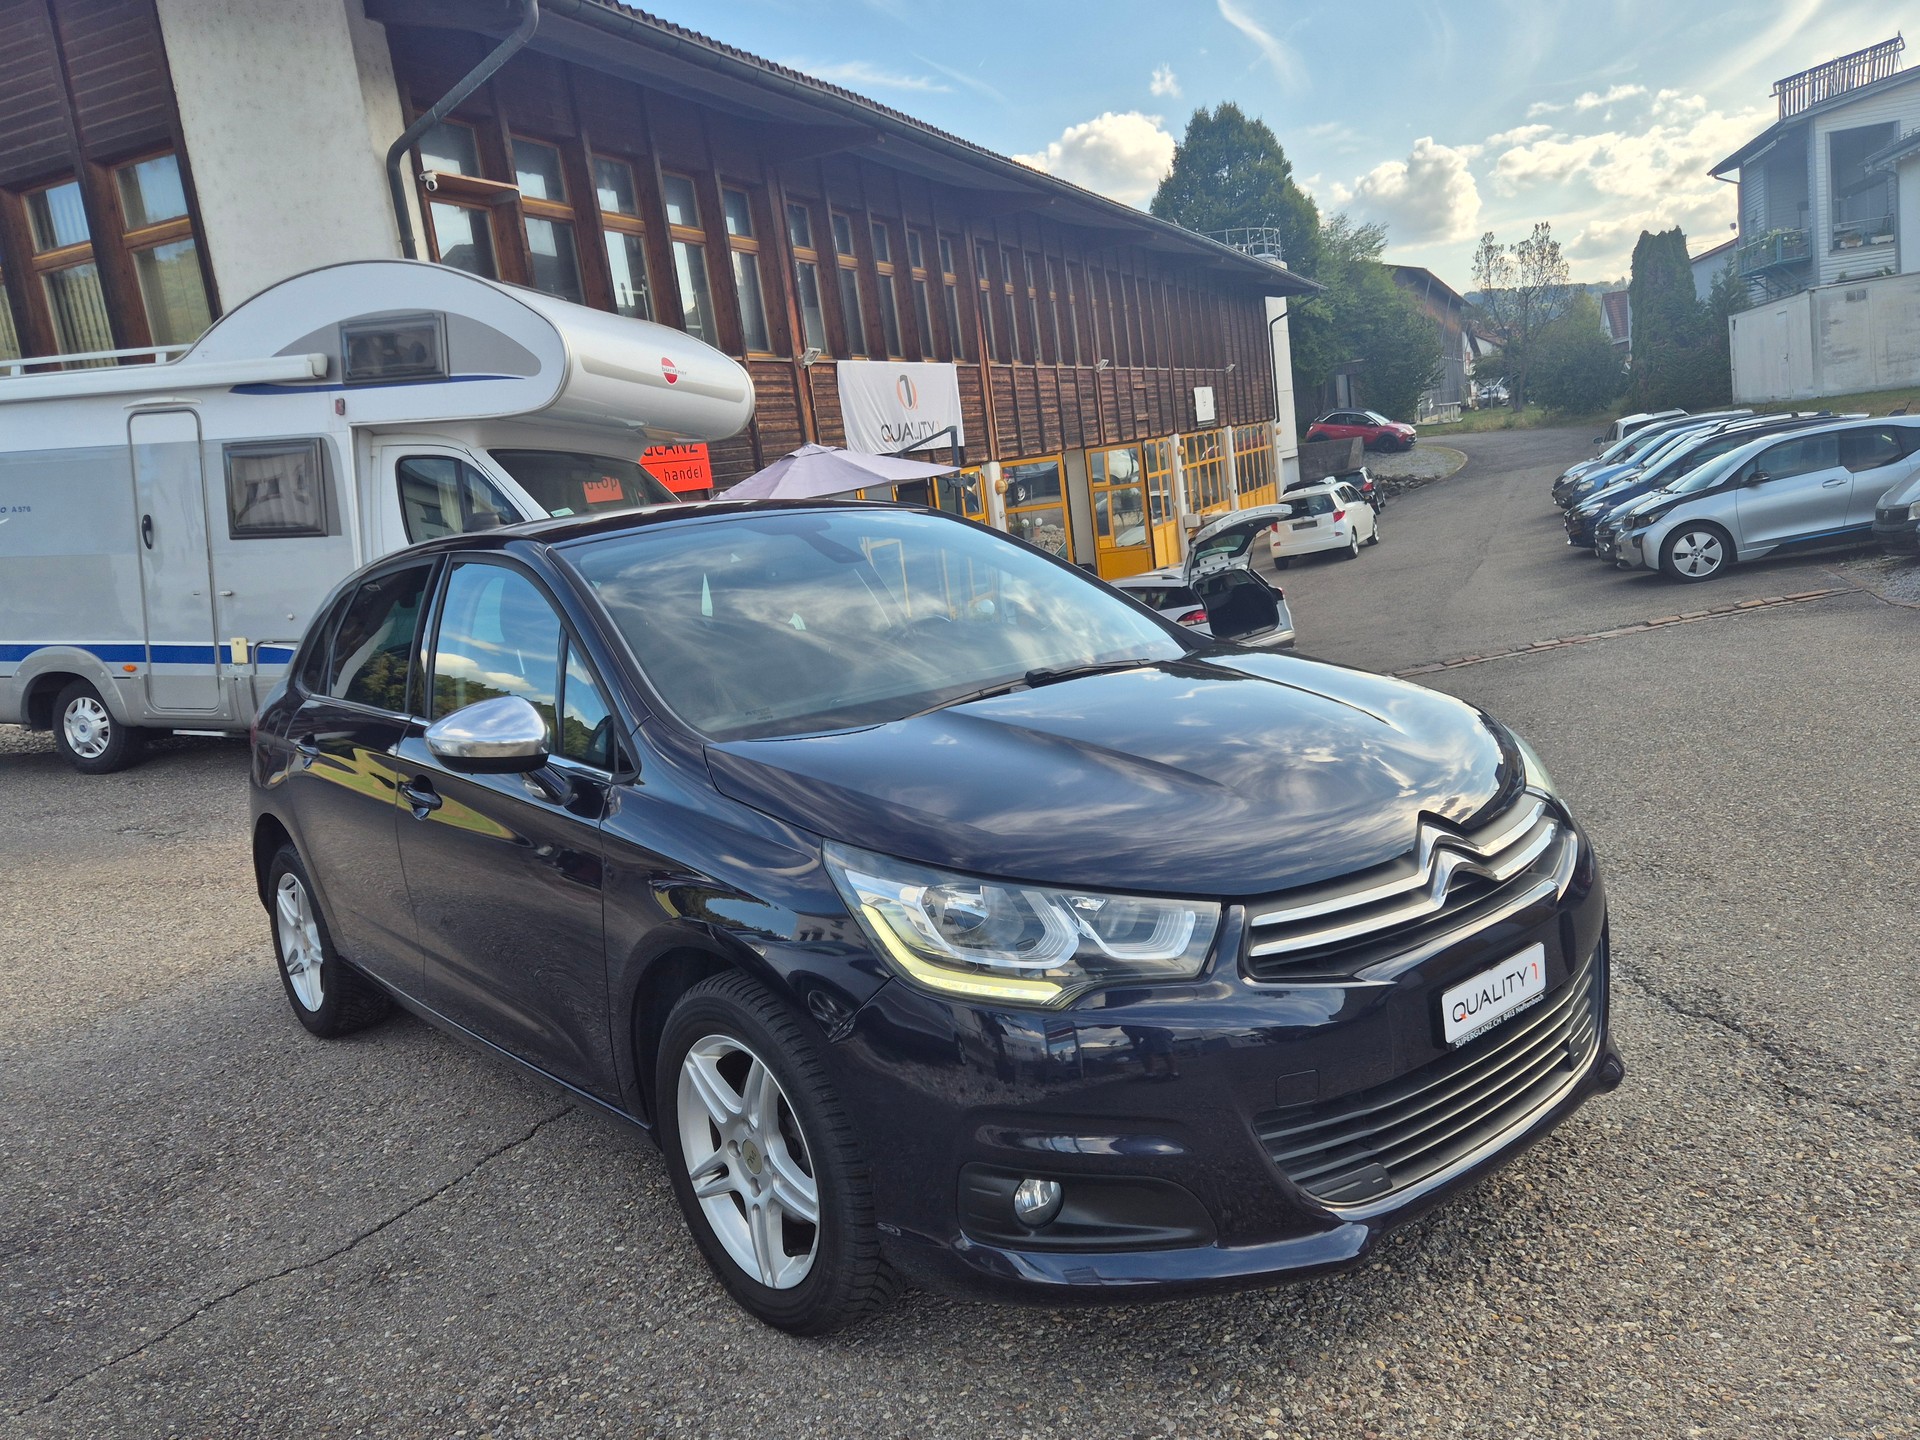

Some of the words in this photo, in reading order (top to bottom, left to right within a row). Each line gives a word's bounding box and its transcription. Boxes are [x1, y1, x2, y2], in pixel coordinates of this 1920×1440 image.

[663, 466, 703, 482] handel
[1455, 1016, 1502, 1048] SUPERGLANZ.CH
[1503, 1010, 1515, 1021] 8413
